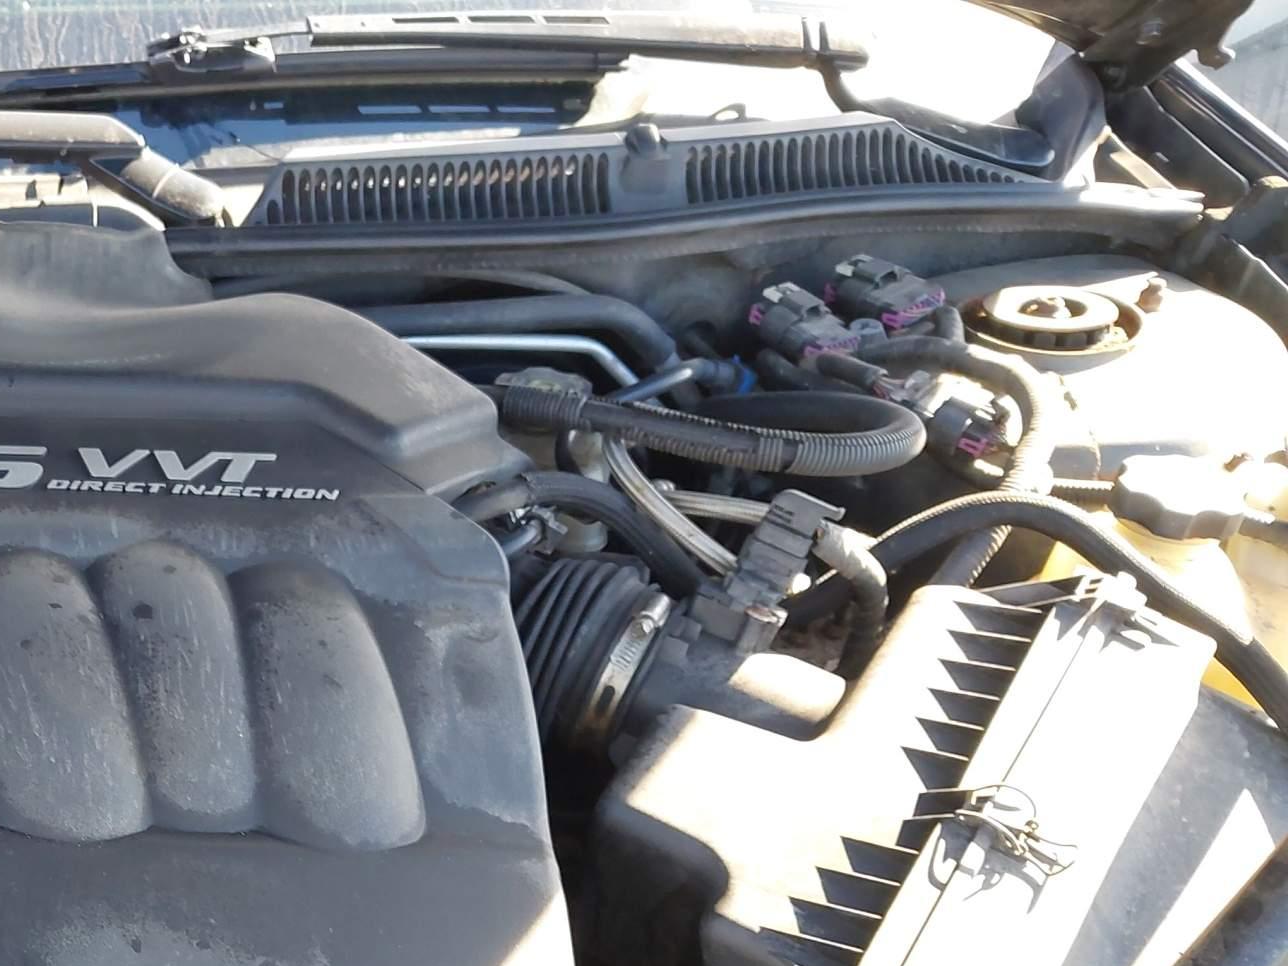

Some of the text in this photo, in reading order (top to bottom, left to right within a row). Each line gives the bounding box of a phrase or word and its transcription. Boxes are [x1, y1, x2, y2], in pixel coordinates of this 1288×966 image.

[77, 447, 277, 483] VVT
[47, 479, 340, 502] DIRECT INJECTION
